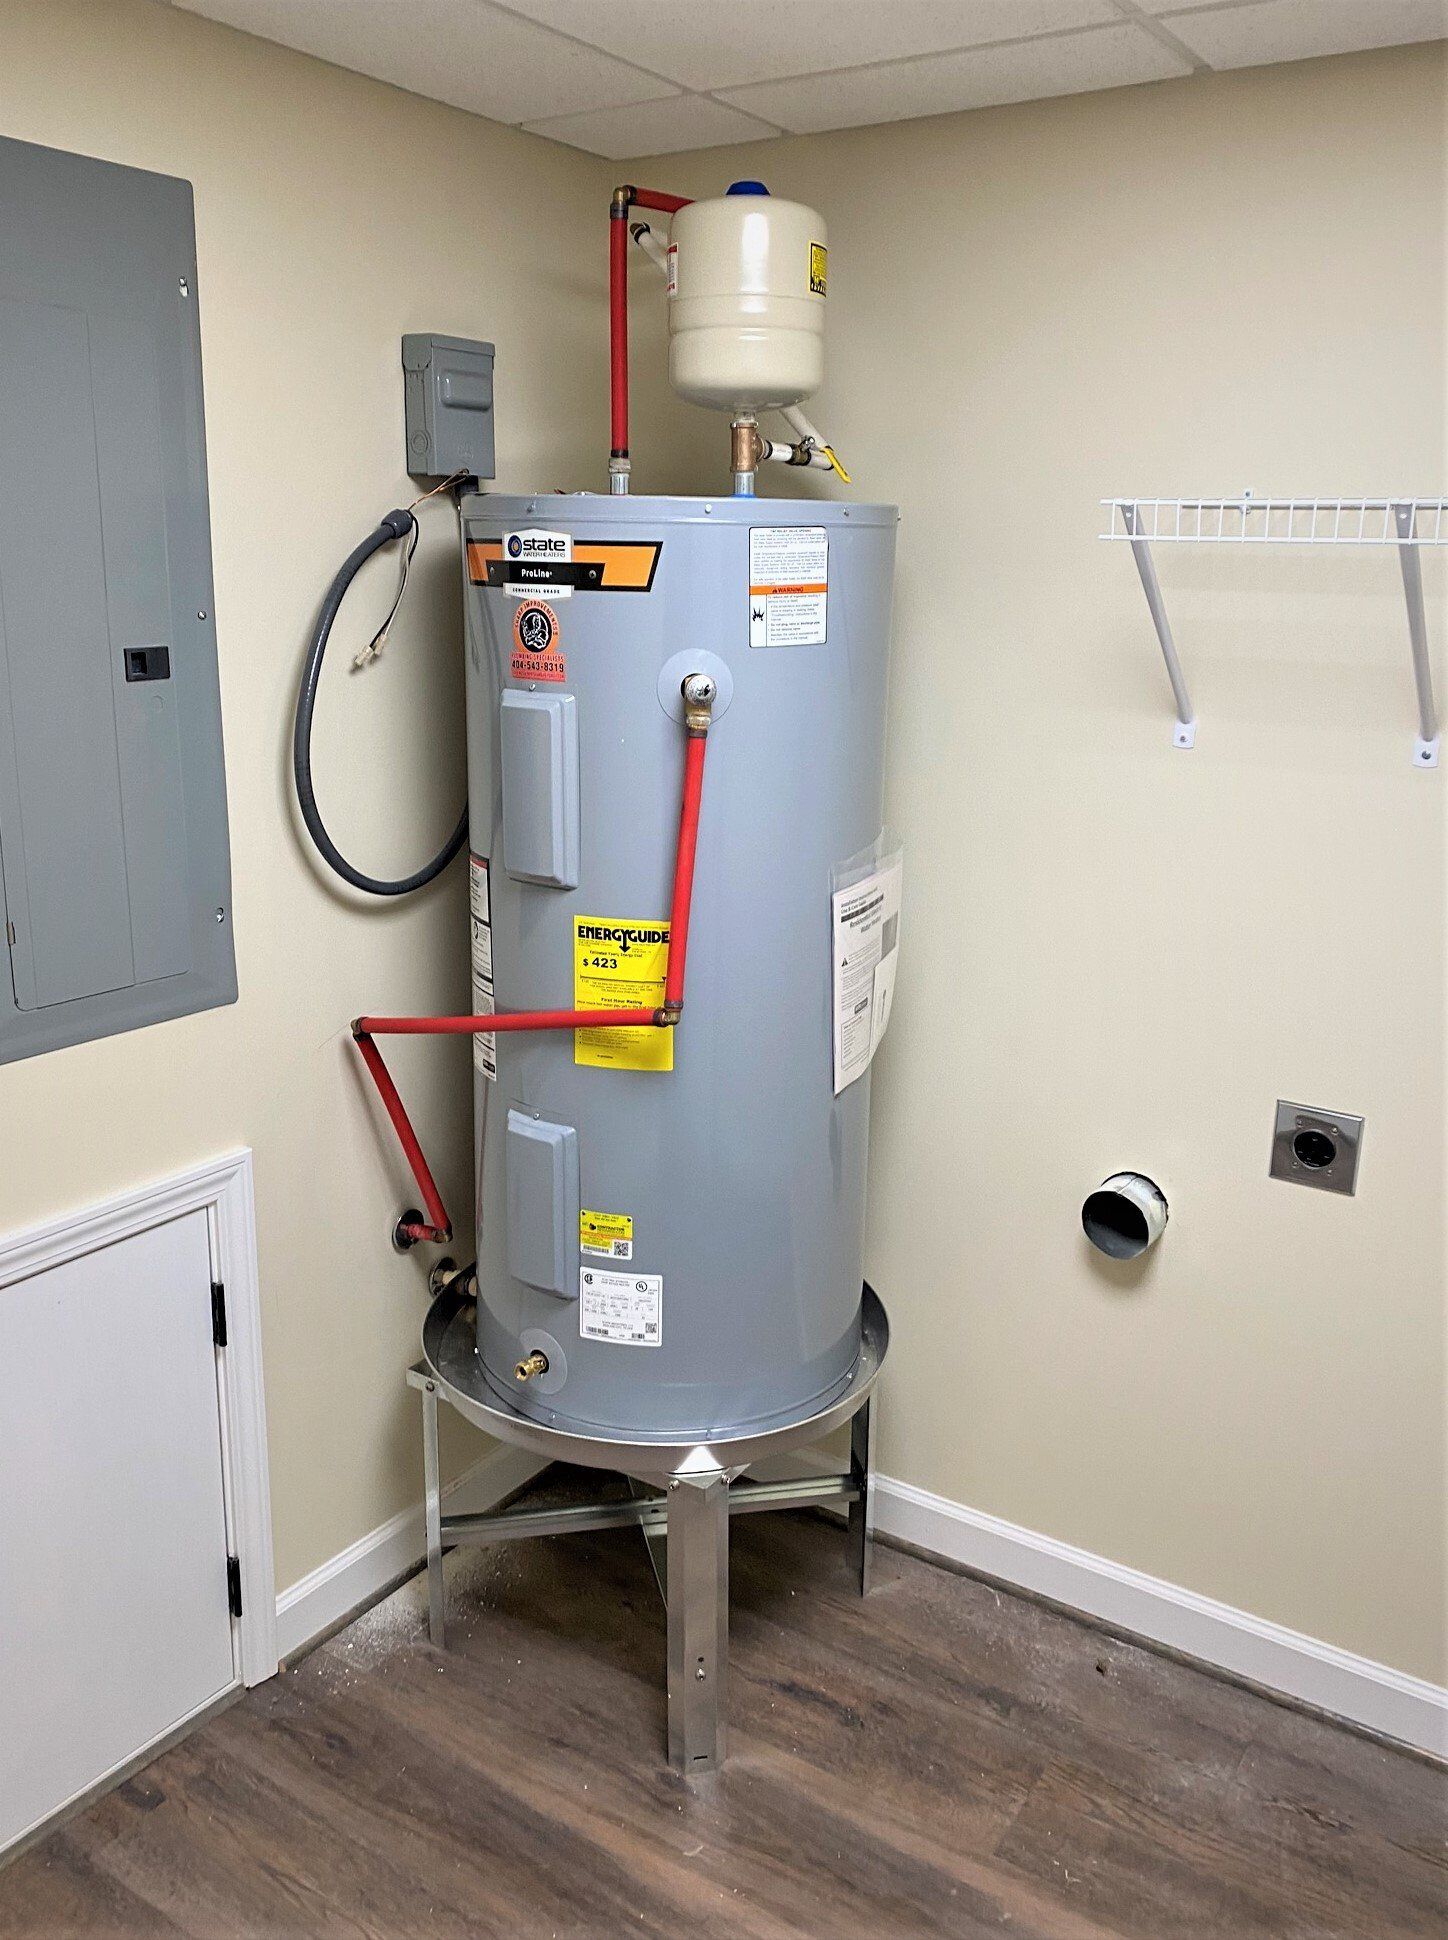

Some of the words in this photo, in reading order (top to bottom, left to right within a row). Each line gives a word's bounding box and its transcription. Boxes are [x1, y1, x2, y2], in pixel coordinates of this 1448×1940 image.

[523, 538, 566, 551] state
[511, 660, 564, 673] 404-543-8319
[578, 925, 670, 944] ENERGYGUIDE
[583, 958, 588, 966] $
[592, 957, 618, 969] 423
